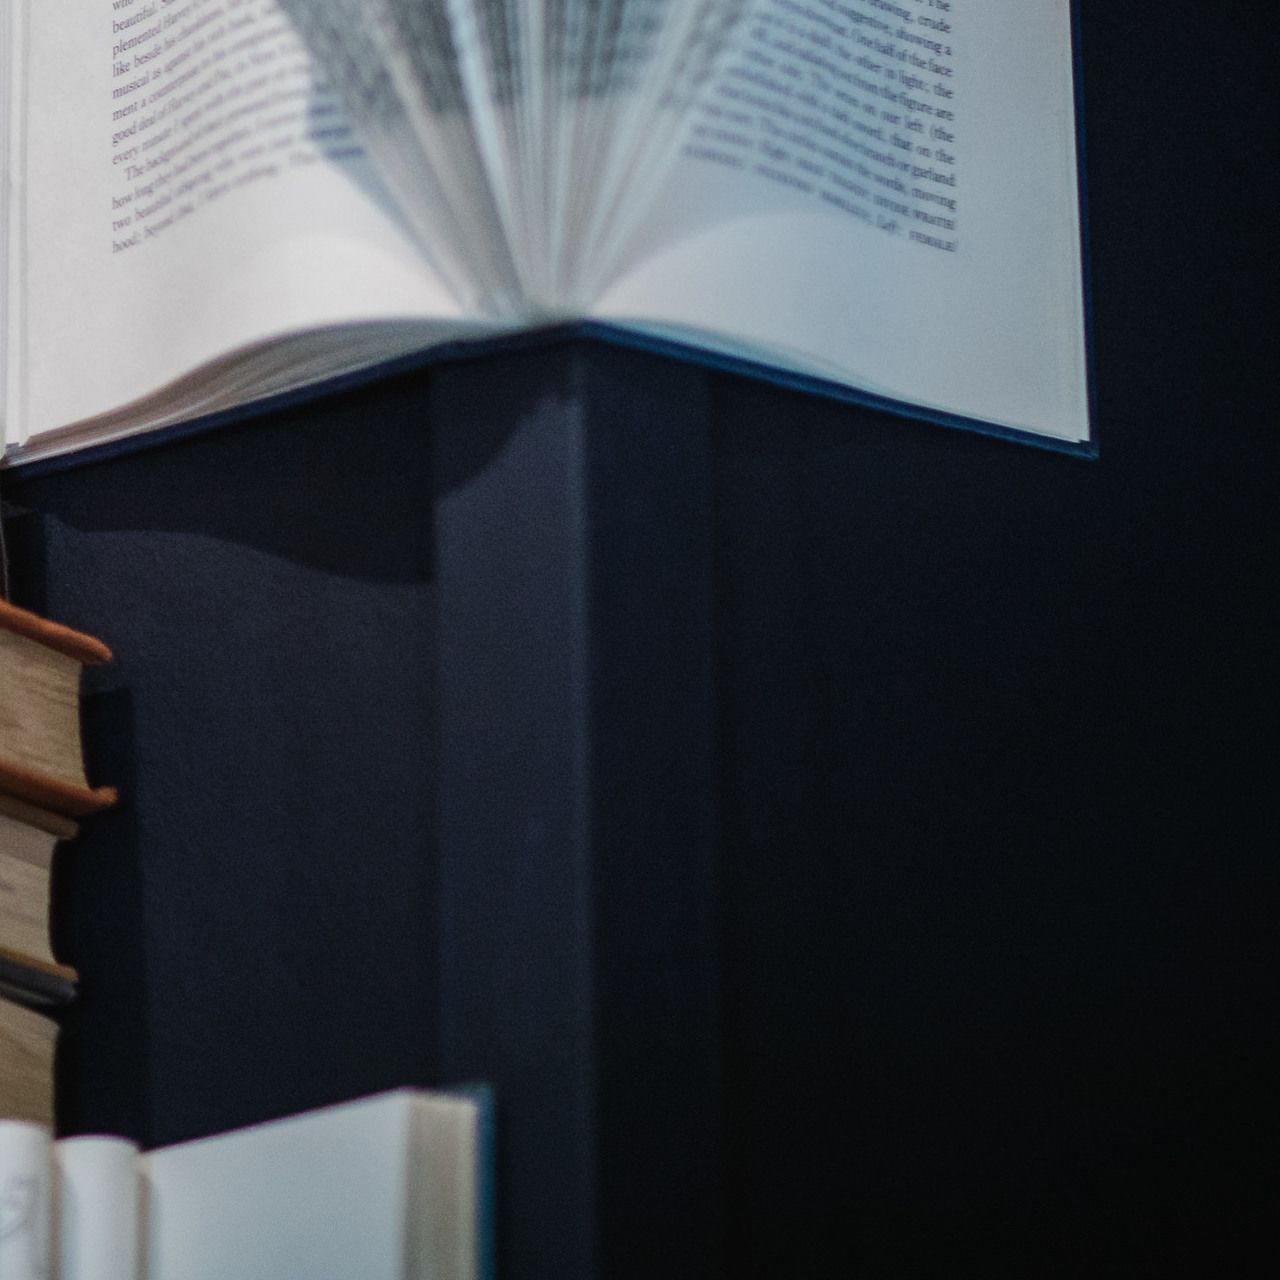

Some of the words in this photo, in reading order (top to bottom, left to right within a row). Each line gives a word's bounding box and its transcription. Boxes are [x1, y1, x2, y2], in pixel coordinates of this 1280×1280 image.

[111, 58, 132, 78] like
[111, 101, 140, 122] ment
[111, 122, 137, 148] good
